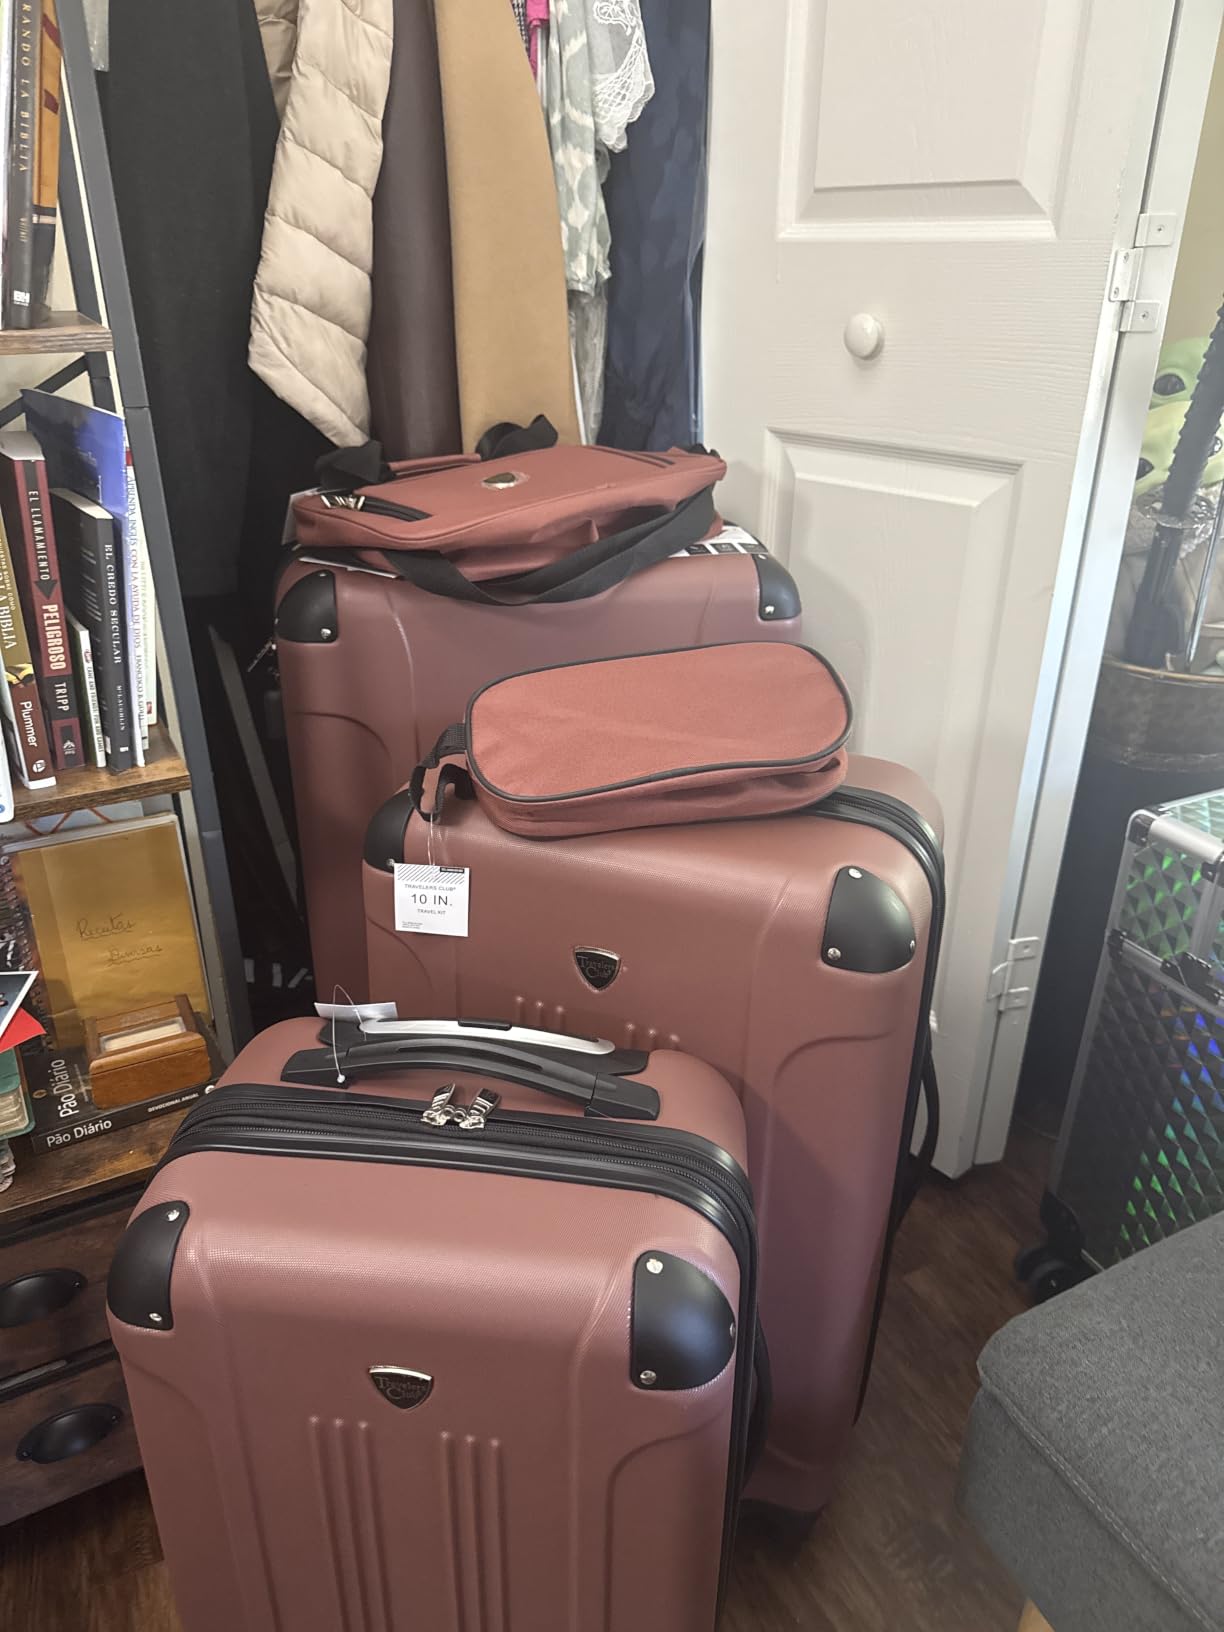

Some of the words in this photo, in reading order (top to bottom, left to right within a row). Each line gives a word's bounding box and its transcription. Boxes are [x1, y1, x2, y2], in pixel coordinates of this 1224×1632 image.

[21, 78, 30, 98] LA
[19, 111, 31, 172] BIBLIA
[28, 490, 39, 503] EL
[31, 507, 50, 580] LLAMAMIENTO
[104, 544, 113, 560] EL
[106, 564, 117, 605] CREDO
[0, 605, 17, 649] BIBLIA
[42, 604, 66, 670] PELIGROSO
[110, 609, 122, 664] SECULAR
[134, 628, 142, 649] DIOS
[54, 682, 70, 712] TRIPP
[20, 700, 37, 747] Plummer
[404, 883, 437, 891] TRAVELERS
[411, 893, 427, 905] 10
[433, 895, 453, 906] IN.
[48, 1059, 73, 1095] Diário
[57, 1093, 80, 1118] Pão
[147, 1099, 181, 1113] DEVOCIONAL
[181, 1093, 200, 1103] ANUAL
[46, 1132, 72, 1148] Pão
[73, 1119, 112, 1138] Diário
